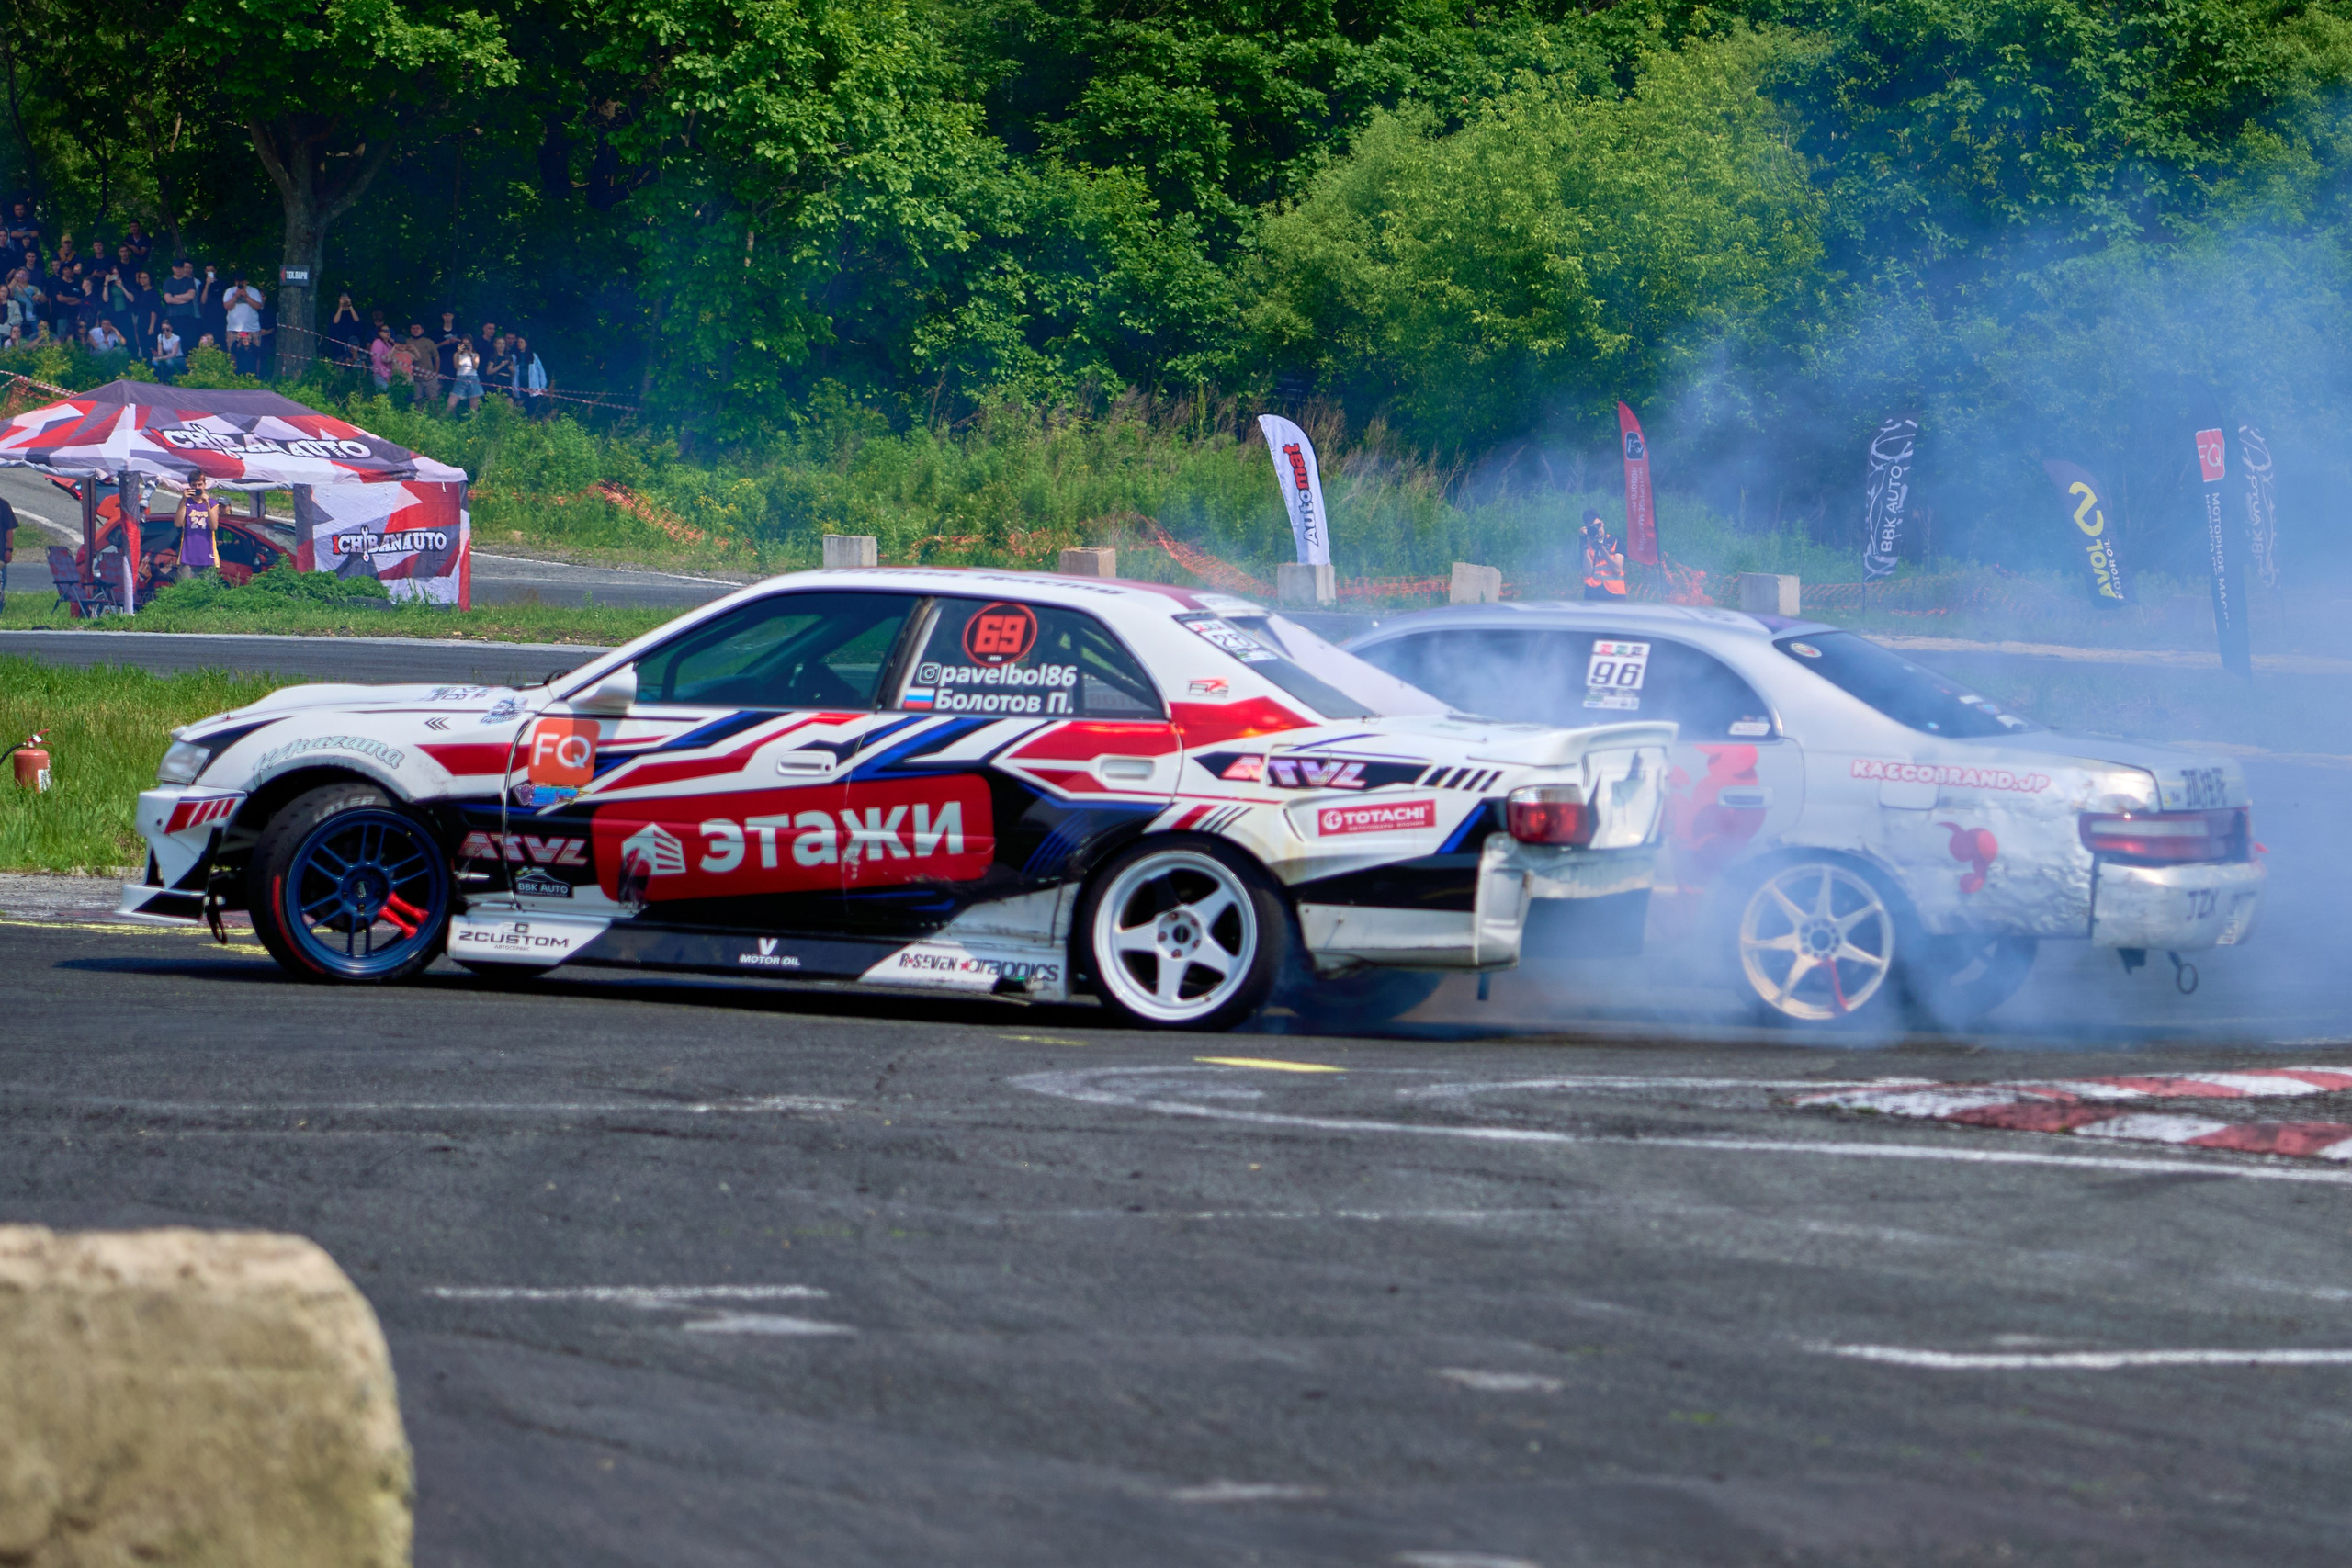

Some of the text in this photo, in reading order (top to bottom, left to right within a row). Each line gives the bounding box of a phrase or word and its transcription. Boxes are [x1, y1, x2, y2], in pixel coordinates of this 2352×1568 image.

[1881, 465, 1903, 552] BBK AUTO
[190, 517, 208, 530] 24
[2104, 538, 2114, 557] OIL
[2086, 538, 2118, 599] AVOL
[973, 615, 1027, 653] 69
[940, 663, 1078, 687] pavelbol86
[1590, 661, 1642, 686] 96
[934, 689, 1041, 712] Болотов
[1046, 692, 1075, 714] П.
[534, 733, 591, 769] FQ
[1344, 807, 1425, 824] TOTACHI
[517, 882, 569, 894] BBK AUTO
[740, 953, 801, 966] MOTOR OIL
